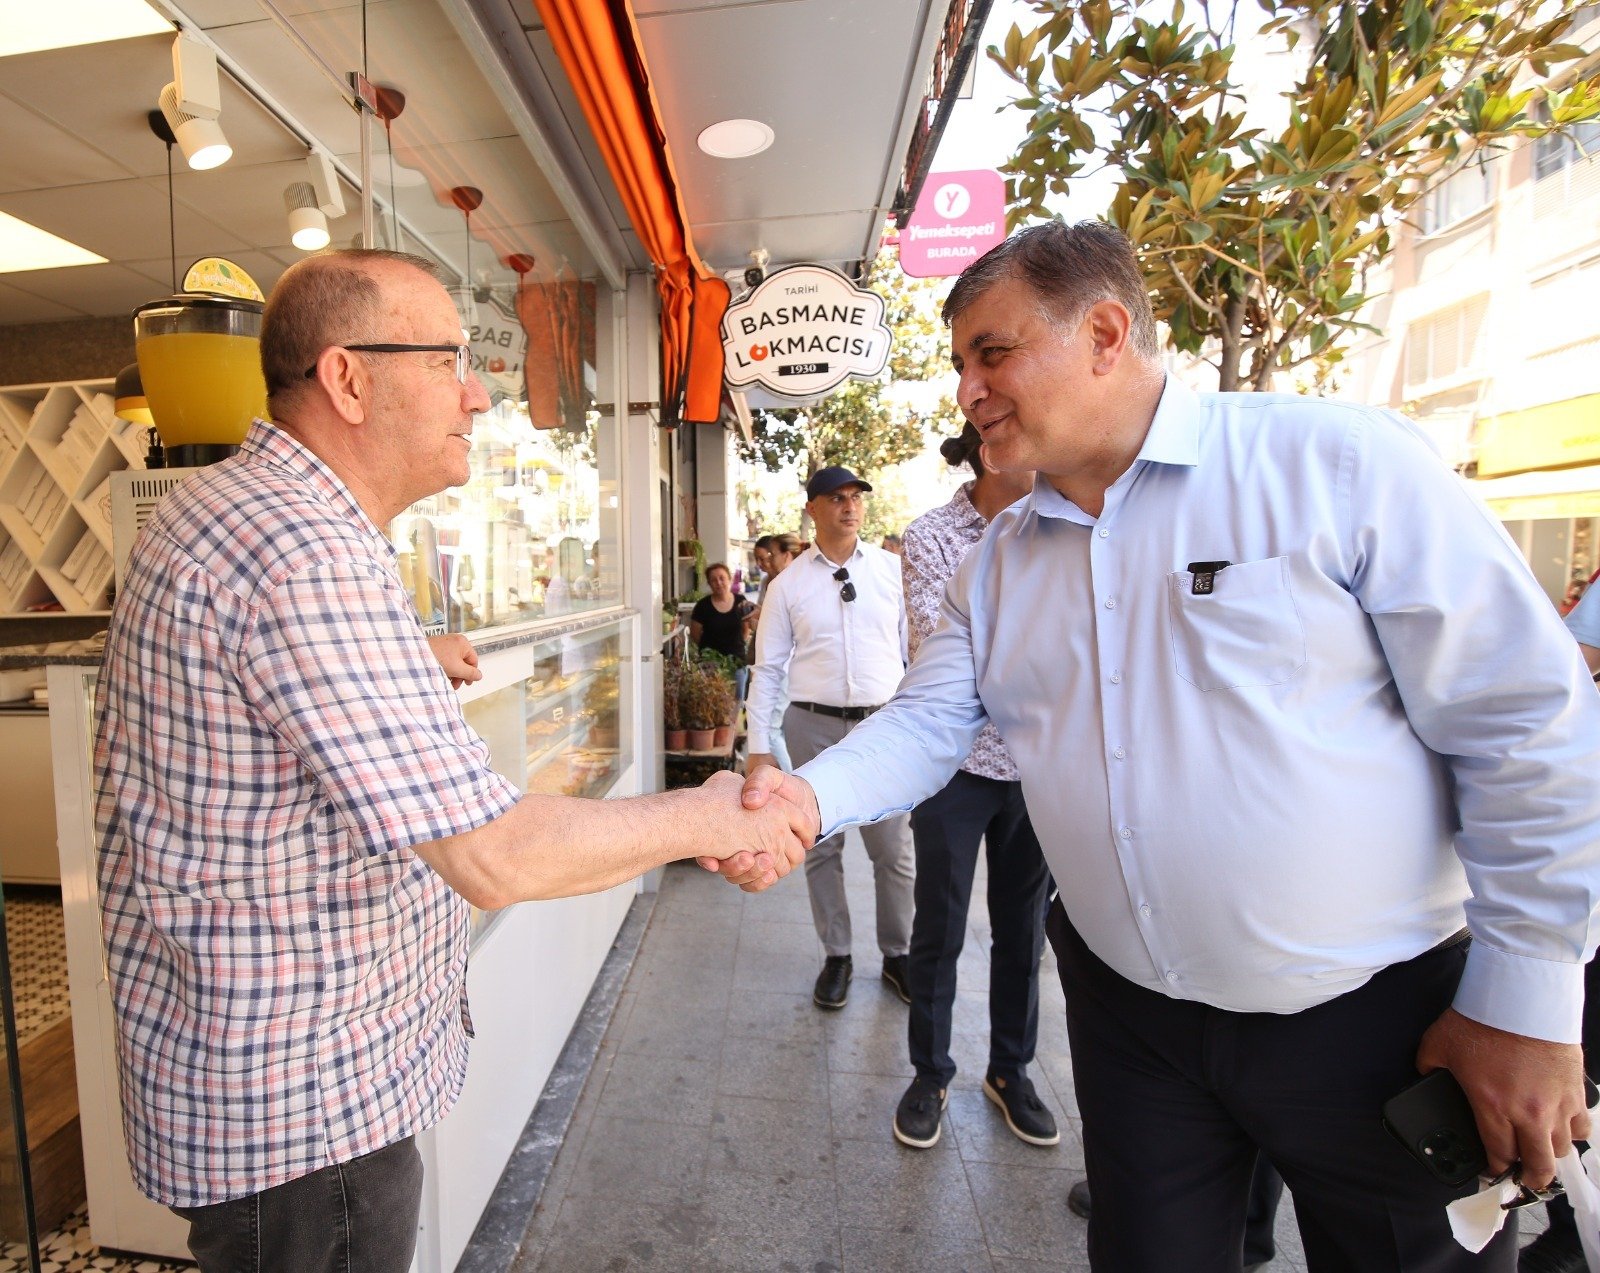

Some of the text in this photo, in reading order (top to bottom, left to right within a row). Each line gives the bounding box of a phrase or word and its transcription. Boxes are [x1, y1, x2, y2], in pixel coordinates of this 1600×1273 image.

[909, 222, 996, 241] Yemeksepeti
[927, 246, 977, 259] BURADA
[785, 285, 819, 296] TARİHİ
[740, 304, 866, 336] BASMANE
[735, 335, 873, 368] LOKMACISI
[790, 364, 817, 374] 1930
